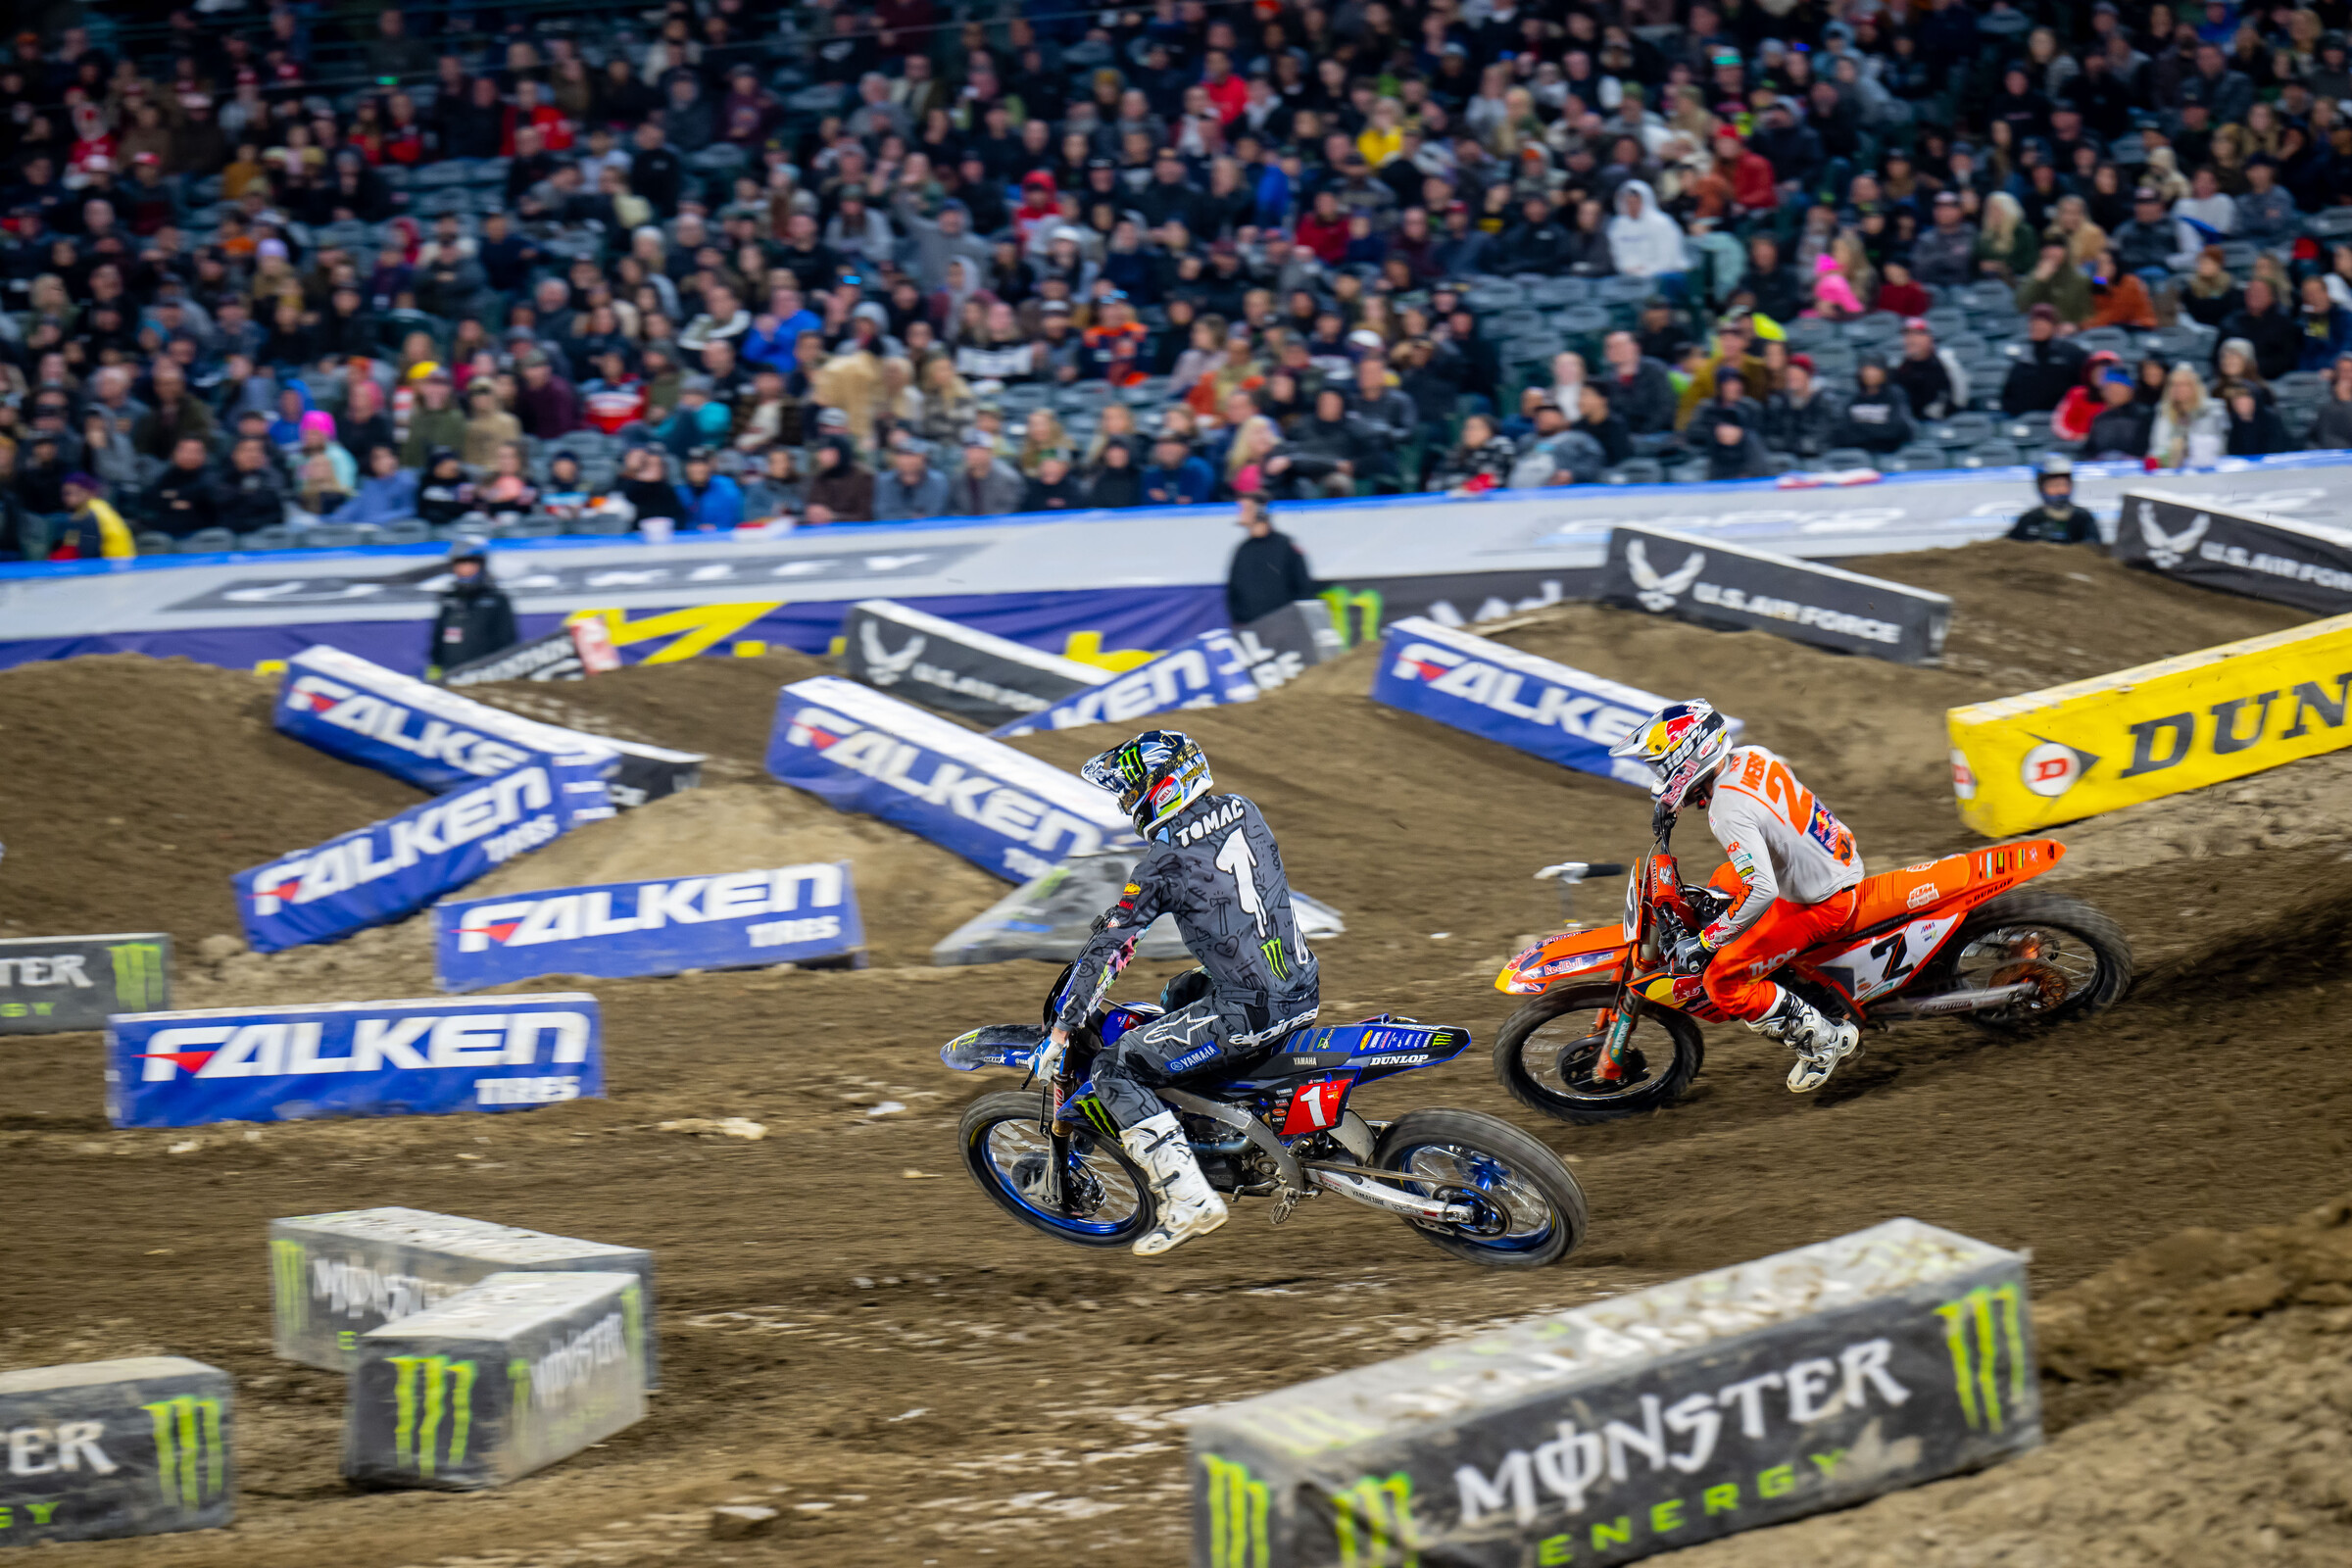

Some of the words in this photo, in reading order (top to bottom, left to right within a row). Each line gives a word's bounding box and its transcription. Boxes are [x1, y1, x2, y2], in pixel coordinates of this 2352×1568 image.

[1693, 582, 1746, 610] U.S.
[1745, 596, 1799, 622] AIR
[1798, 607, 1901, 644] FORCE
[1392, 642, 1656, 750] FALKE
[286, 675, 532, 776] FALKE
[787, 708, 1102, 858] FALKEN
[1158, 788, 1172, 803] BELL
[1766, 760, 1813, 837] 2
[253, 766, 552, 915] FALKEN
[1176, 799, 1245, 848] TOMAC
[458, 862, 843, 953] FALKEN
[1216, 825, 1268, 938] 1
[1544, 960, 1563, 976] Red
[1564, 956, 1583, 971] Bull
[1749, 948, 1797, 977] THOR
[1870, 932, 1914, 981] 2
[140, 1010, 592, 1083] FALKEN
[1182, 1045, 1217, 1068] YAMAHA
[1293, 1056, 1317, 1066] YAMAHA
[1370, 1054, 1429, 1066] DUNLOP
[1615, 1021, 1631, 1051] MOTOREX
[474, 1076, 582, 1106] TIRES
[1299, 1085, 1327, 1127] 1
[1351, 1189, 1386, 1207] YAMALUBE
[0, 1421, 120, 1476] ER
[1454, 1338, 1912, 1527] MONSTER
[1539, 1447, 1849, 1568] ENERGY
